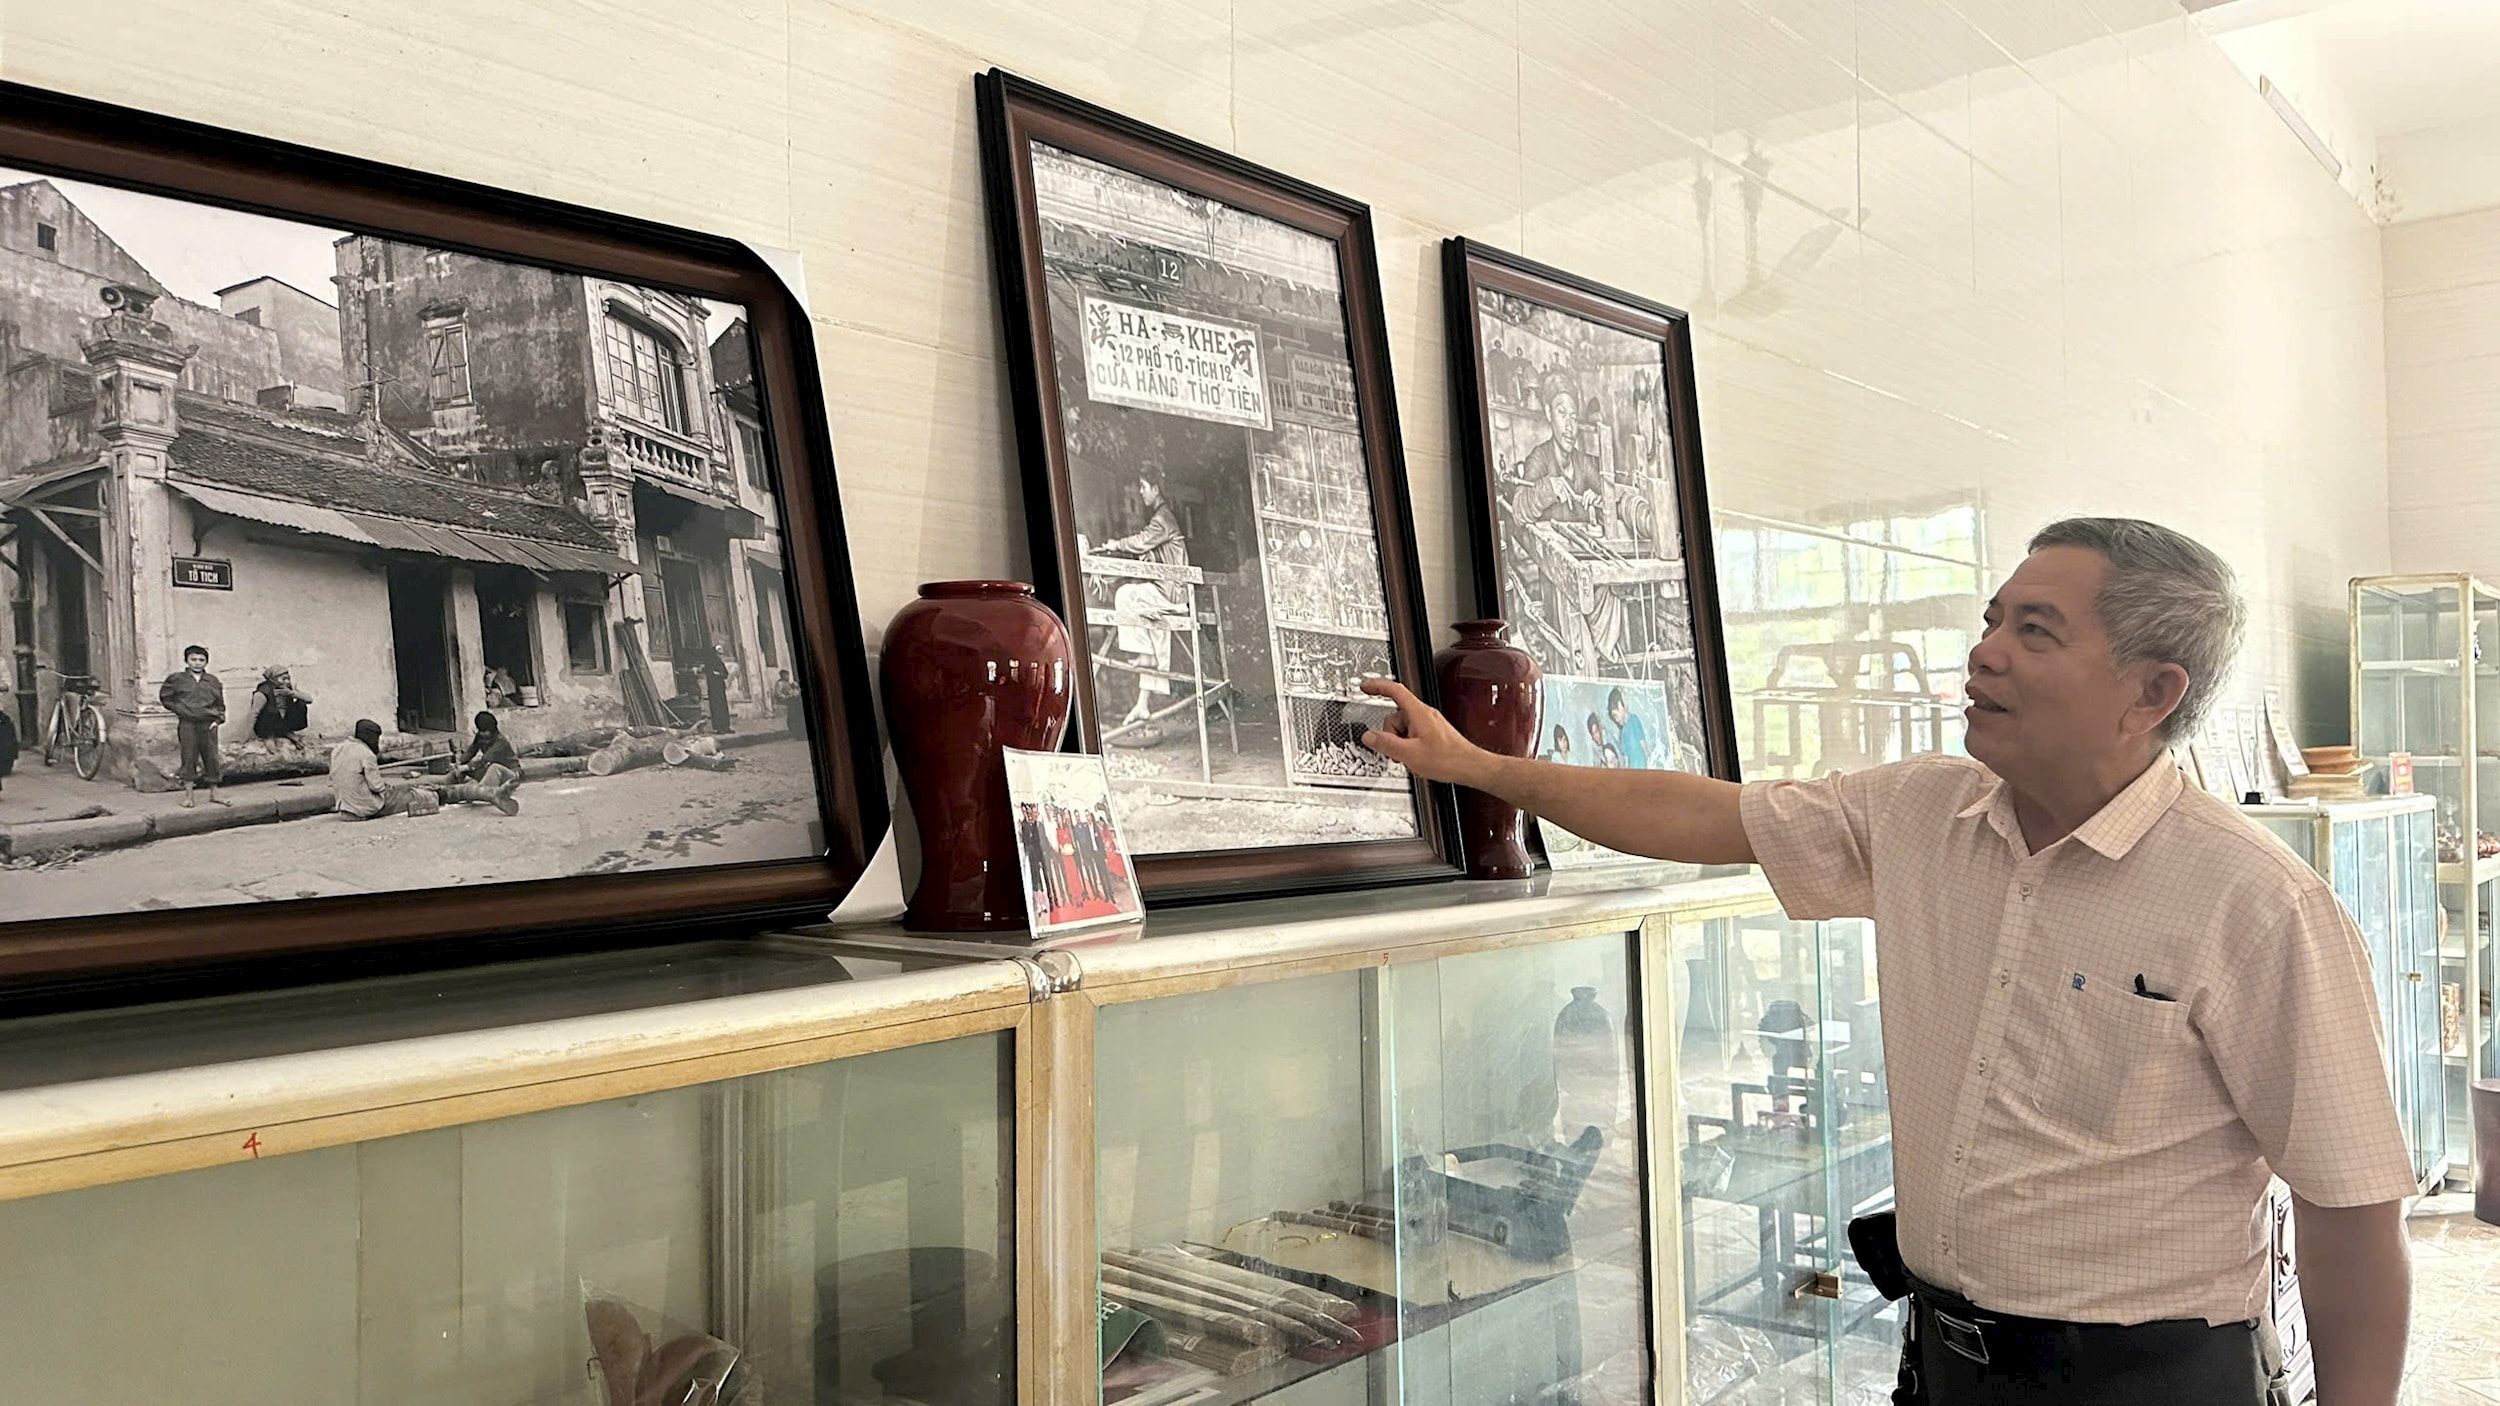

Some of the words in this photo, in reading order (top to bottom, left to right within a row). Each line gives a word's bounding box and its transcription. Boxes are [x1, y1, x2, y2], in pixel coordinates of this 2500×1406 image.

[1161, 258, 1180, 281] 12
[1185, 324, 1228, 356] KHE
[1119, 343, 1134, 364] 12
[1219, 364, 1233, 383] 12
[242, 1131, 262, 1160] 4
